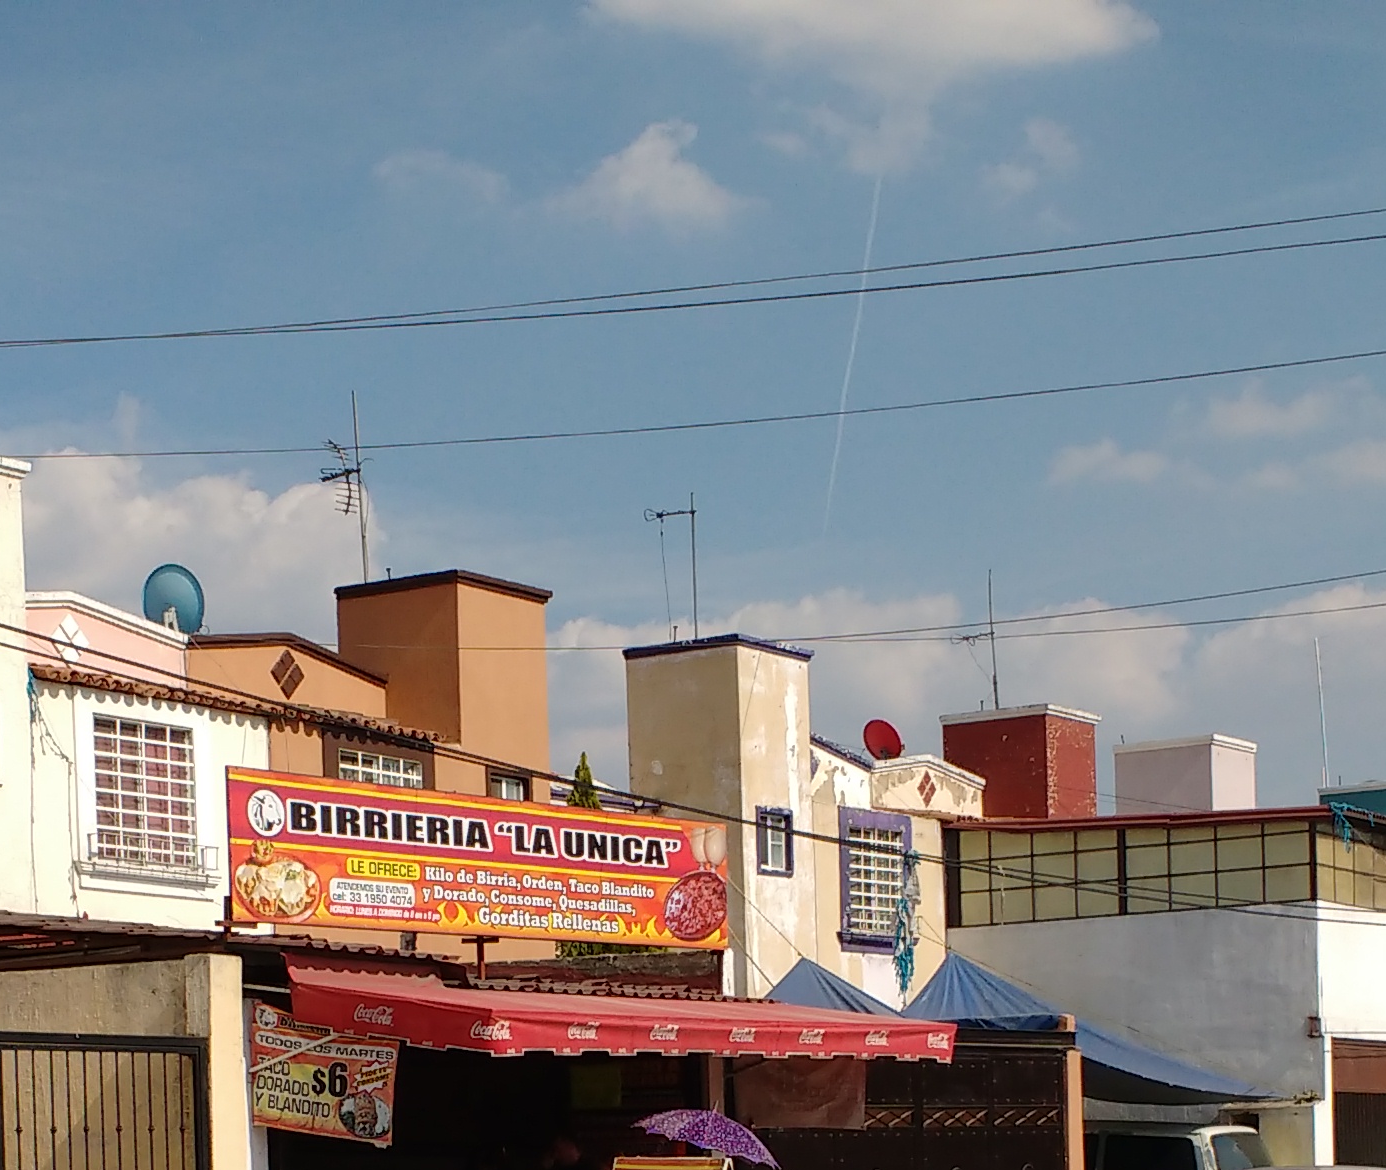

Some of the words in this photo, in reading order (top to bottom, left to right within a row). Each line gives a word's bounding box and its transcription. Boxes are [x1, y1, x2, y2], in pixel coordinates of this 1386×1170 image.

[288, 799, 491, 851] BIRRIERIA
[351, 859, 365, 874] LE
[369, 861, 417, 878] OFRECE:
[336, 881, 373, 893] ATENDEMOS
[375, 884, 384, 893] SU
[385, 885, 408, 895] EVENTO
[425, 866, 453, 882] Kilo
[457, 869, 473, 883] de
[476, 871, 520, 890] Birria,
[522, 876, 566, 894] Orden,
[569, 878, 599, 894] Taco
[601, 881, 654, 898] Blandito
[350, 892, 361, 902] 33
[365, 893, 387, 904] 1950
[390, 895, 413, 905] 4074
[422, 888, 431, 902] y
[434, 885, 488, 904] Dorado,
[491, 889, 556, 909] Consome,
[559, 895, 636, 915] Quesadillas,
[478, 907, 548, 928] Gorditas
[552, 912, 619, 933] Rellenas
[258, 1034, 302, 1049] TODOS
[335, 1047, 394, 1060] MARTES
[256, 1075, 310, 1097] DORADO
[312, 1062, 348, 1098] $6
[255, 1092, 264, 1106] Y
[268, 1094, 331, 1118] BLANDITO
